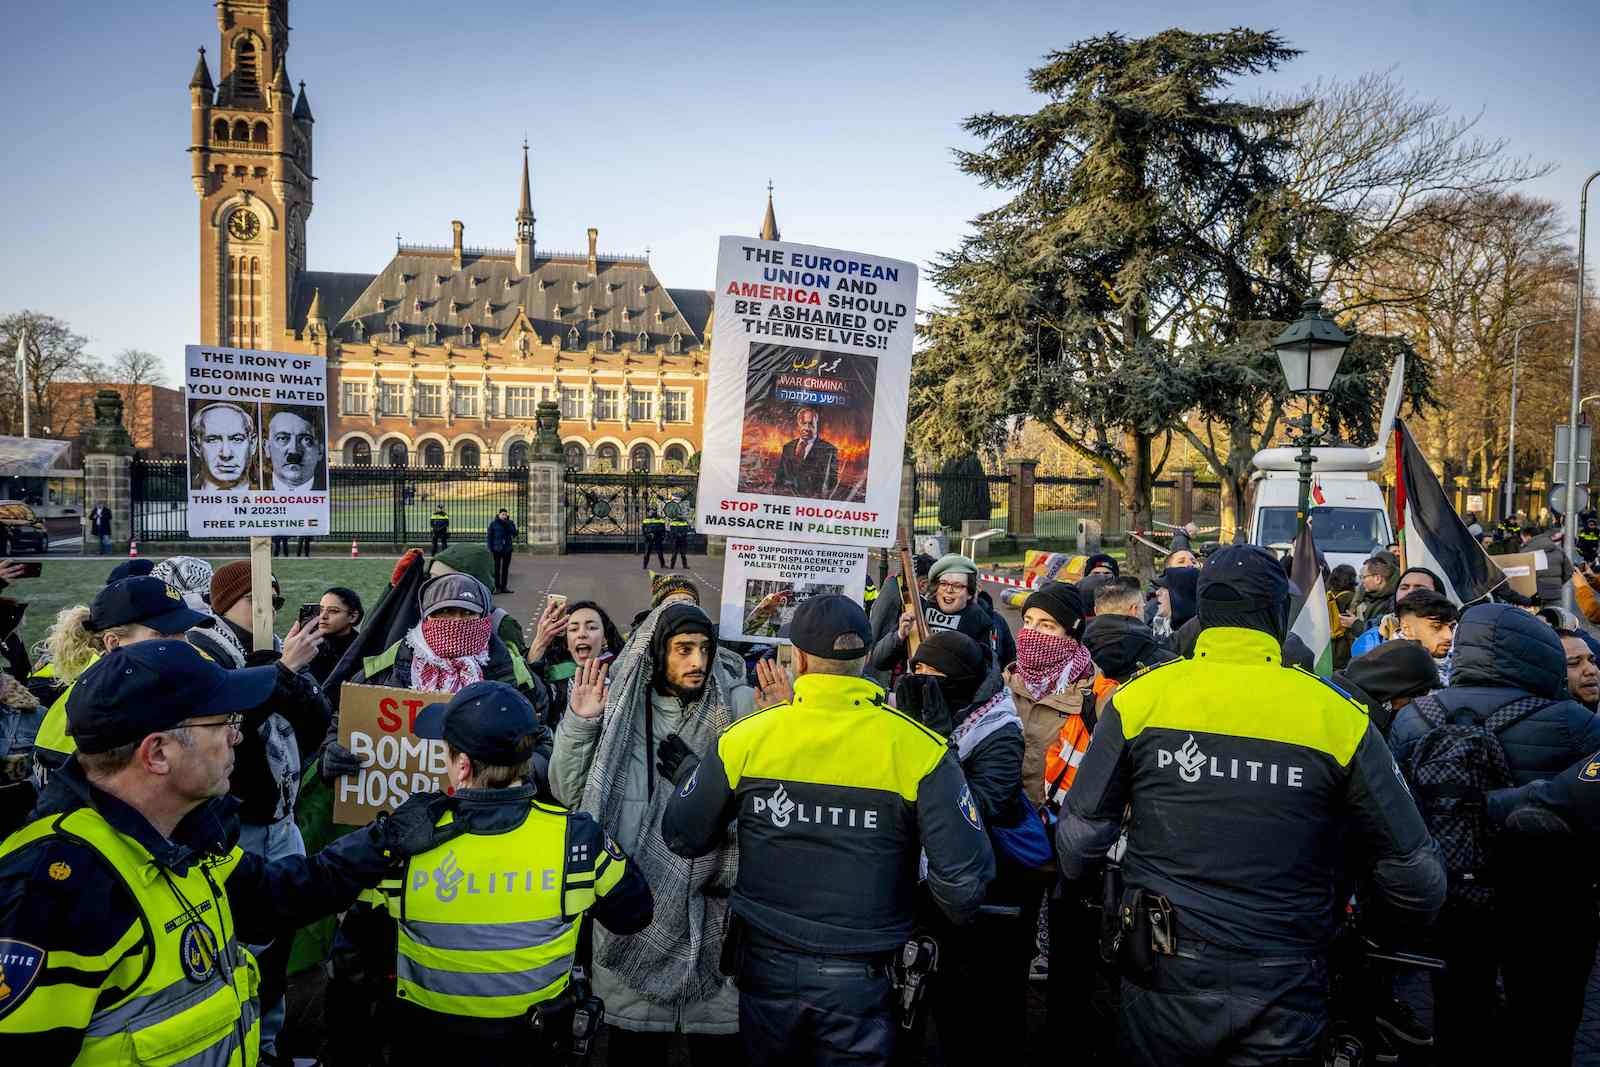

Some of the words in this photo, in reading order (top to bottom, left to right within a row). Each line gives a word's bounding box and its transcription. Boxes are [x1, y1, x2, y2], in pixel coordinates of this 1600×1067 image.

[742, 246, 784, 265] THE
[791, 253, 899, 282] EUROPEAN
[764, 267, 830, 288] UNION
[836, 278, 877, 296] AND
[726, 281, 821, 306] AMERICA
[828, 294, 907, 318] SHOULD
[734, 300, 762, 316] BE
[768, 304, 867, 330] ASHAMED
[873, 318, 898, 334] OF
[742, 318, 888, 350] THEMSELVES!!
[201, 352, 234, 364] THE
[239, 355, 287, 369] IRONY
[292, 360, 312, 370] OF
[190, 368, 275, 384] BECOMING
[280, 374, 322, 386] WHAT
[779, 375, 802, 387] WAR
[804, 377, 848, 393] CRIMINAL
[188, 384, 222, 396] YOU
[228, 386, 271, 398] ONCE
[276, 390, 325, 401] HATED
[192, 495, 222, 504] THIS
[226, 496, 239, 504] IS
[241, 496, 251, 504] A
[255, 496, 326, 505] HOLOCAUST
[234, 507, 247, 515] IN
[250, 507, 287, 515] 2023!!
[720, 500, 759, 512] STOP
[763, 503, 791, 515] THE
[795, 506, 879, 522] HOLOCAUST
[203, 520, 235, 529] FREE
[239, 519, 304, 528] PALESTINE
[705, 515, 784, 531] MASSACRE
[789, 521, 803, 532] IN
[808, 523, 889, 539] PALESTINE!!
[738, 552, 757, 560] AND
[779, 555, 844, 566] DISPLACEMENT
[757, 545, 814, 557] SUPPORTING
[816, 550, 864, 559] TERRORISM
[744, 561, 802, 571] PALESTINIAN
[804, 565, 836, 573] PEOPLE
[780, 572, 808, 580] EGYPT
[928, 609, 956, 625] NOT
[377, 697, 424, 736] ST
[340, 770, 440, 809] HOSPi
[0, 953, 35, 967] ITIE
